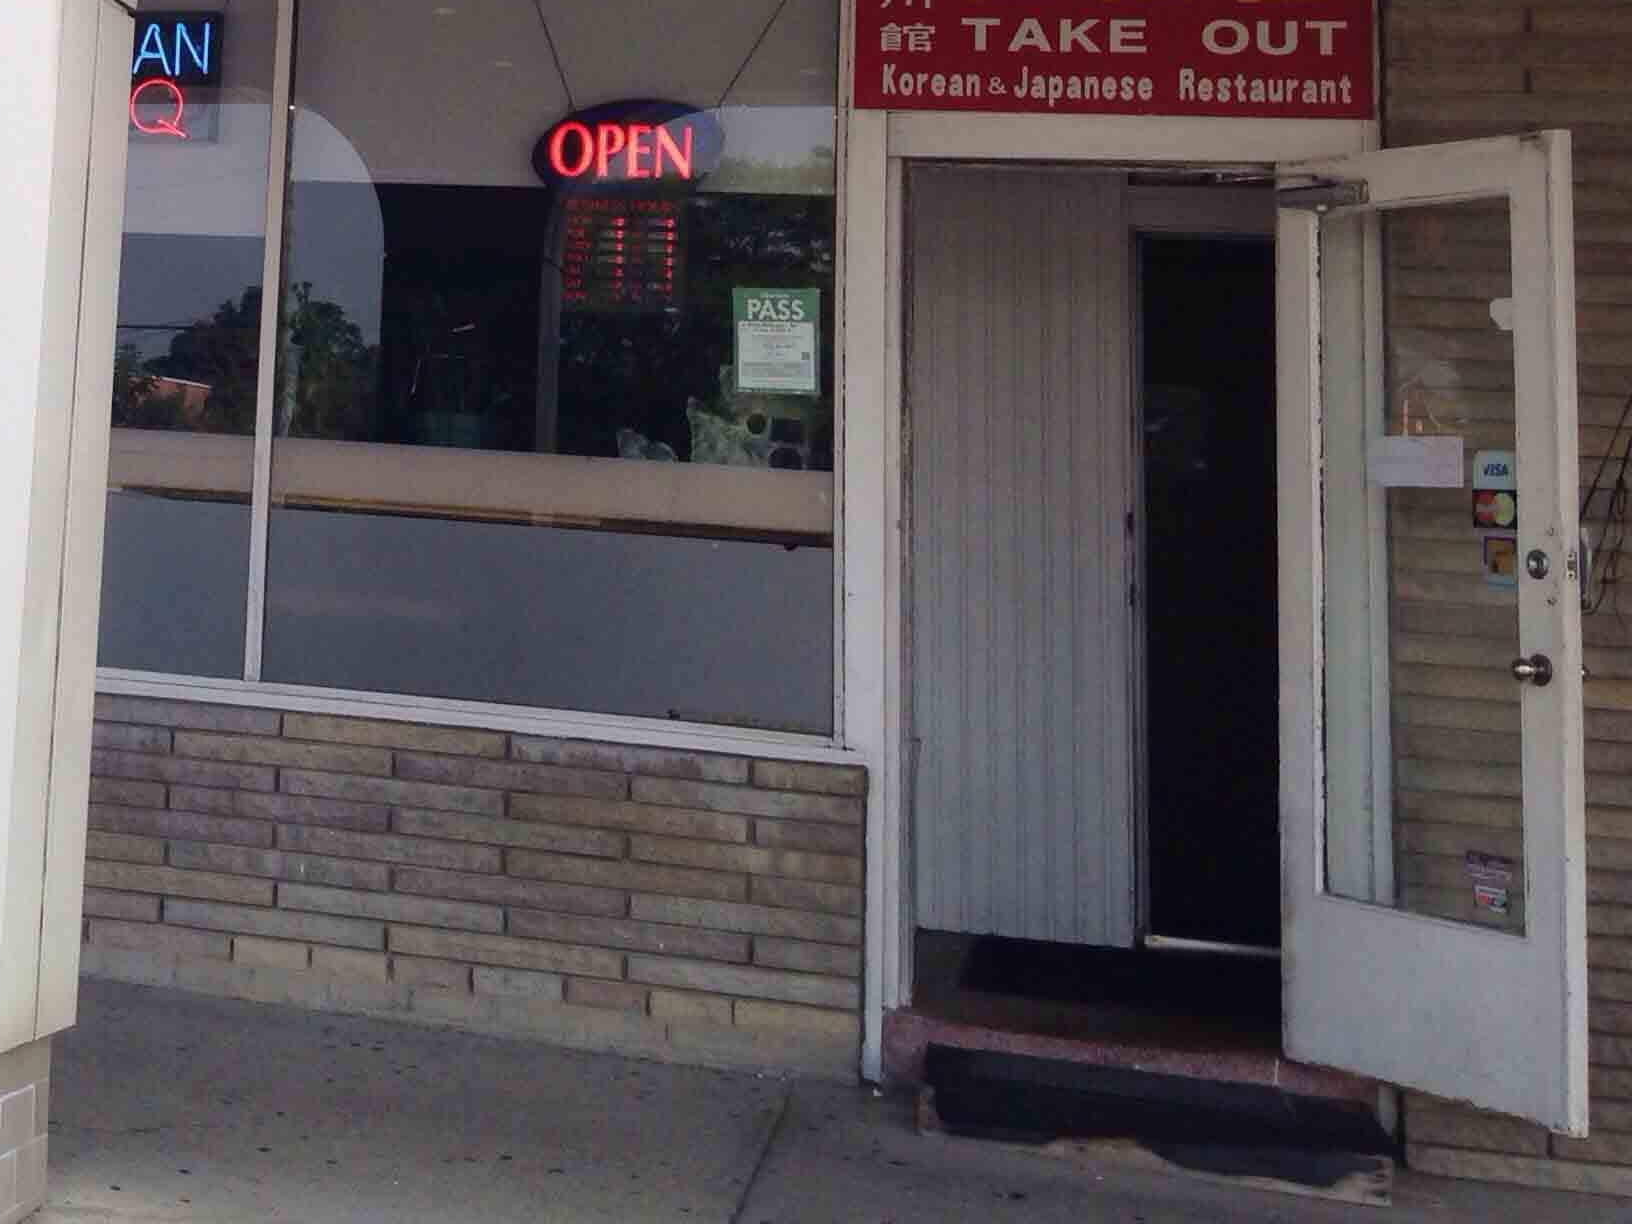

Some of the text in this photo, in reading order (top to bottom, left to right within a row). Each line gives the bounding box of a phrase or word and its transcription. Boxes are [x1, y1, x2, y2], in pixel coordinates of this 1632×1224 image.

[961, 17, 1348, 56] TAKE OUT
[882, 64, 1352, 107] Korean & Japanese Restaurant
[546, 121, 693, 180] OPEN
[746, 298, 805, 321] PASS
[1483, 463, 1509, 477] VISA
